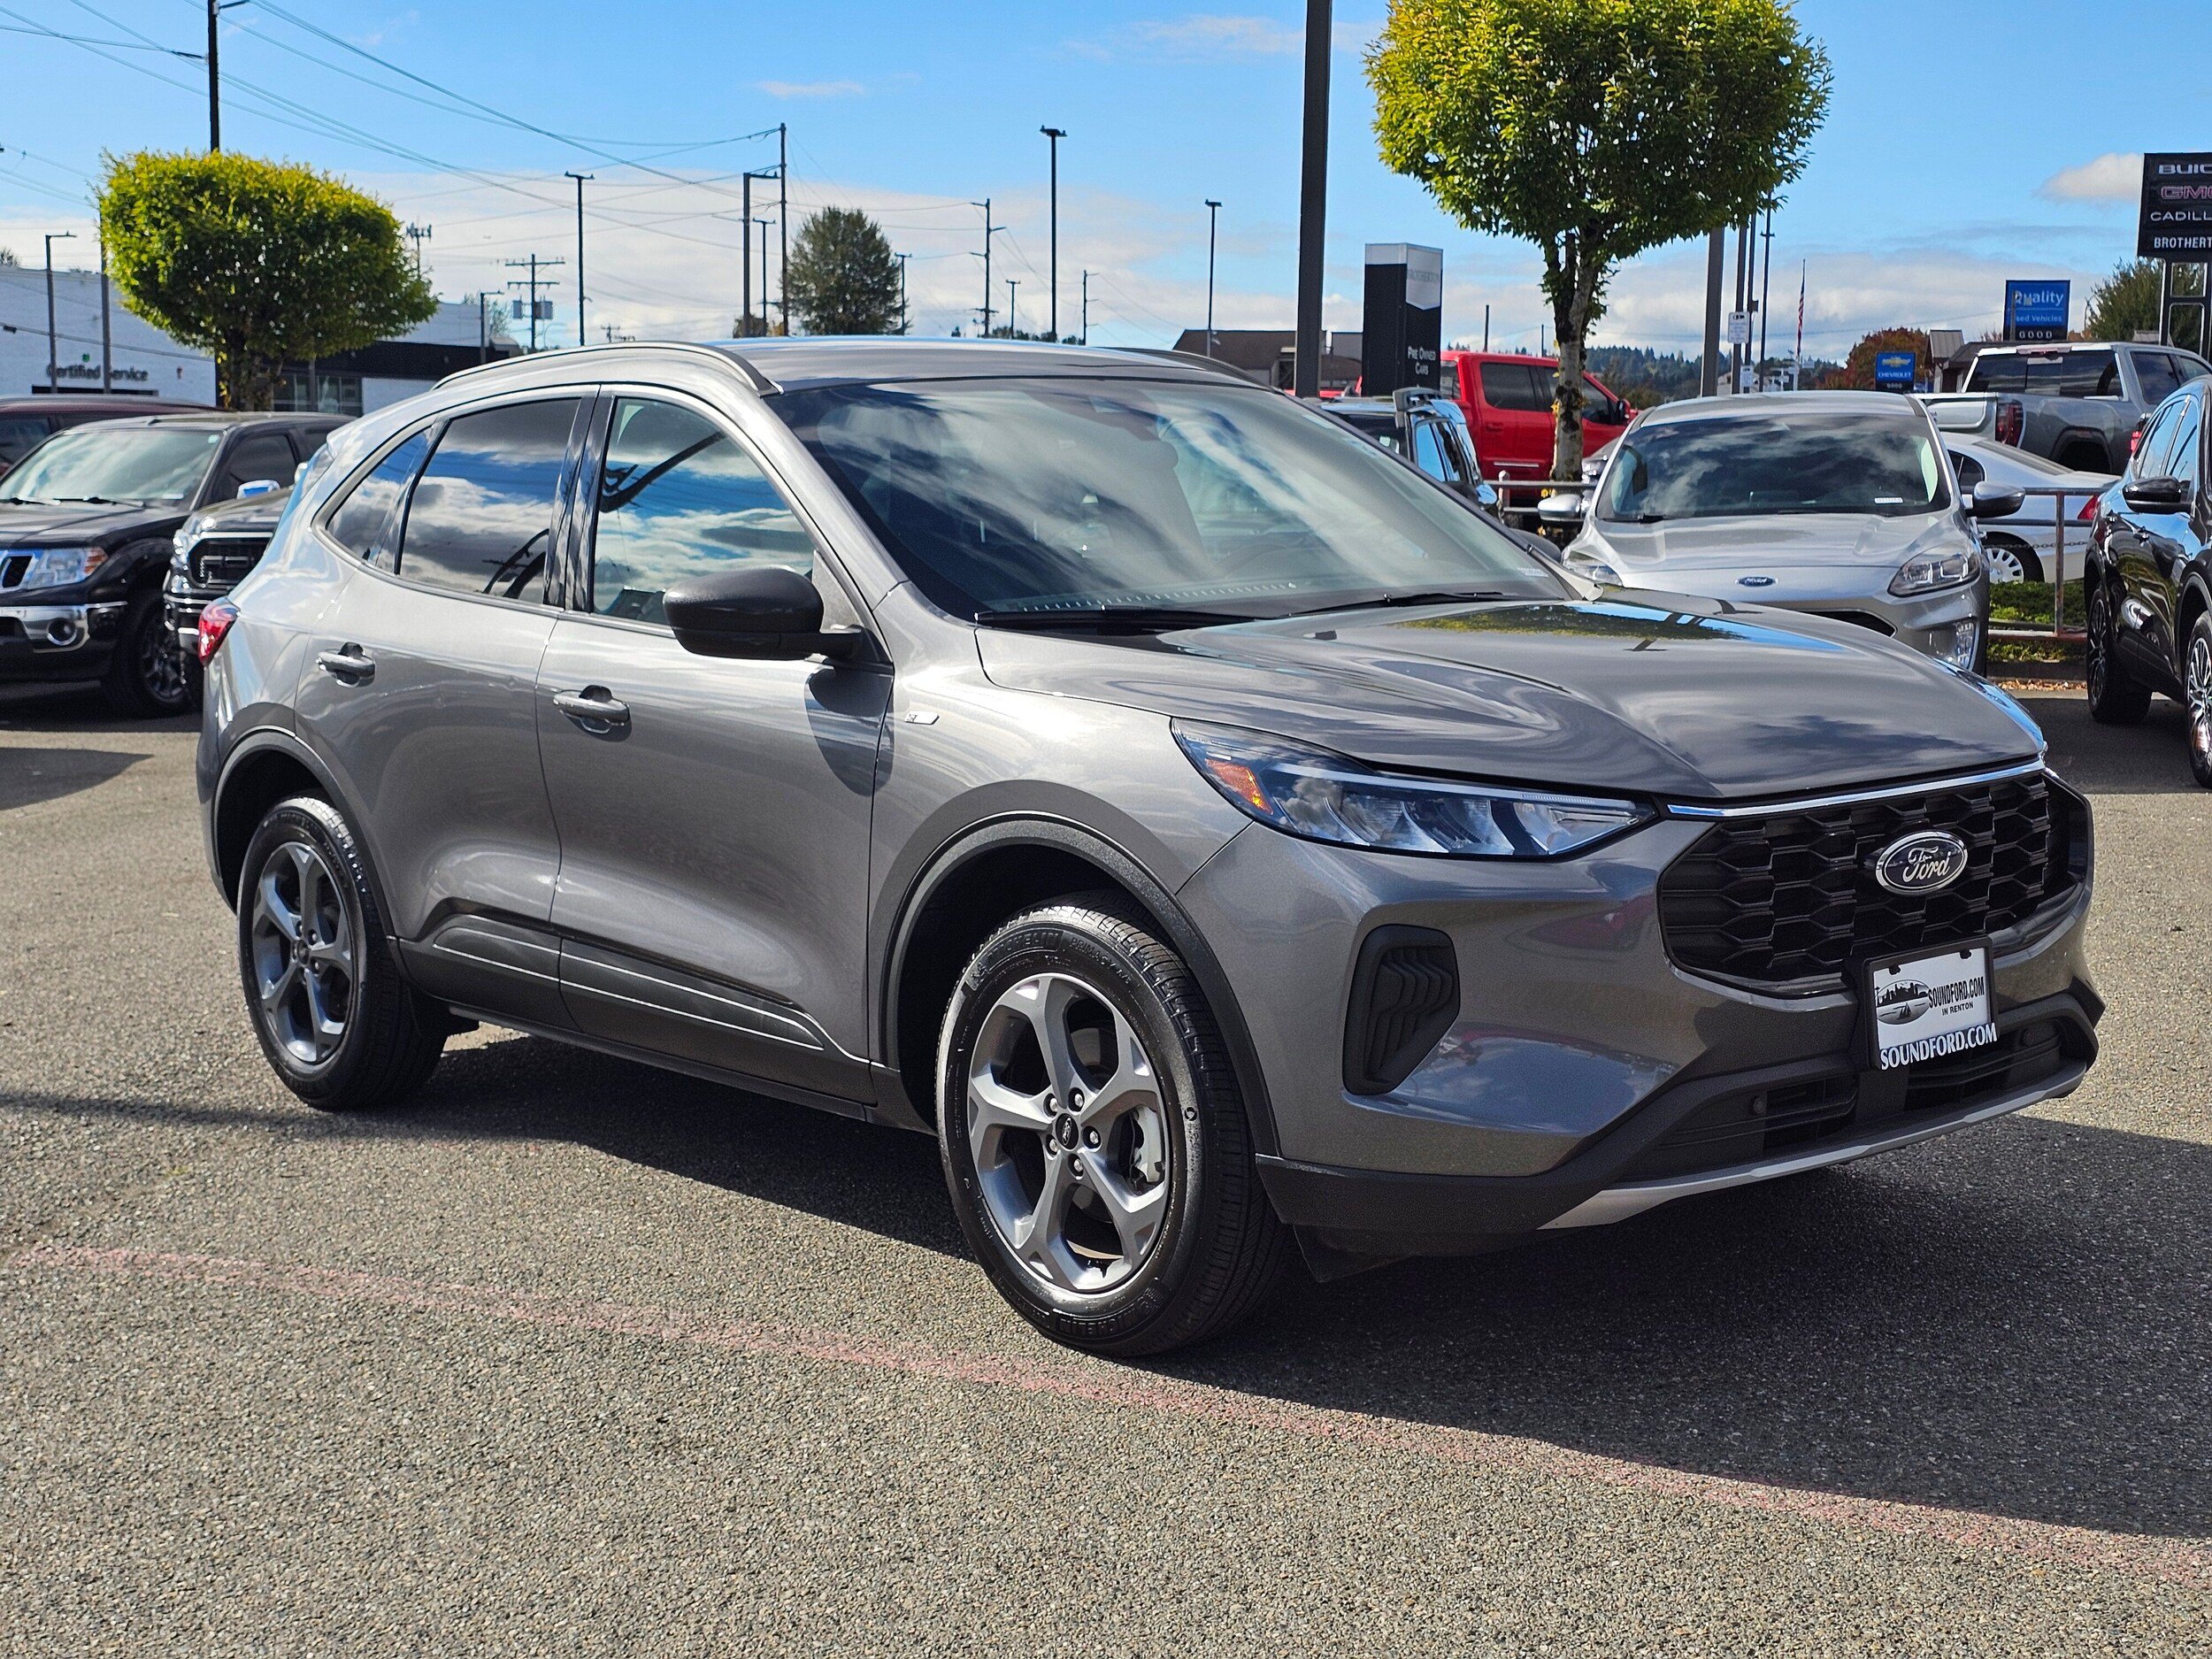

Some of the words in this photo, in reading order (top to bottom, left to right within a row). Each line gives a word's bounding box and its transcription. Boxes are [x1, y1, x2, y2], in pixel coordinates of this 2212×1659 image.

[2162, 185, 2212, 200] GM
[107, 365, 149, 381] ervice
[1902, 846, 1950, 883] Ford
[1928, 976, 1985, 1009] SOUNDFORD.COM
[1949, 1001, 1974, 1015] RENTON
[1880, 1022, 1998, 1071] SOUNDFORD.COM
